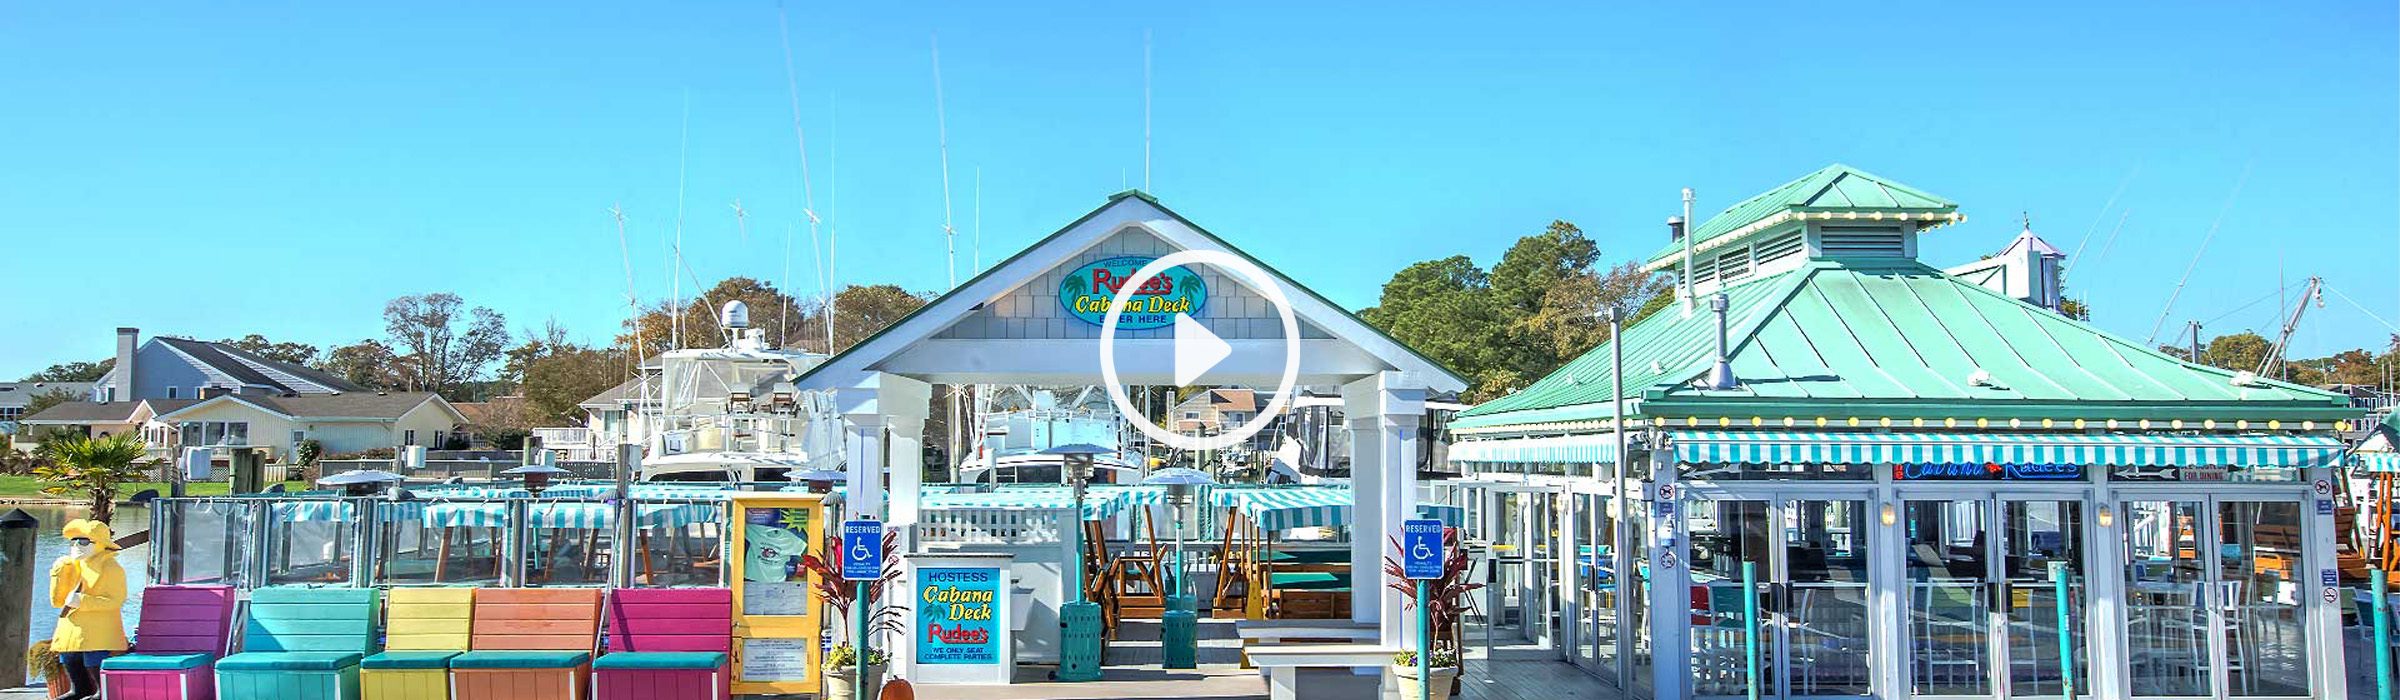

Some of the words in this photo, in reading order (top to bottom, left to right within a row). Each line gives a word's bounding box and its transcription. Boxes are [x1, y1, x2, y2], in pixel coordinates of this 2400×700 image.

[1104, 259, 1148, 268] WELCOME
[1092, 267, 1174, 295] Rue's
[1075, 296, 1142, 314] Cabna
[1148, 295, 1190, 313] Deck
[1100, 315, 1134, 324] EER
[1138, 315, 1166, 324] HERE
[845, 525, 880, 534] RESERVED
[1405, 524, 1442, 533] RESERVED
[928, 572, 988, 582] HOSTESS
[923, 585, 993, 604] Cabana
[948, 603, 992, 620] Deck
[928, 623, 989, 645] Rudee's
